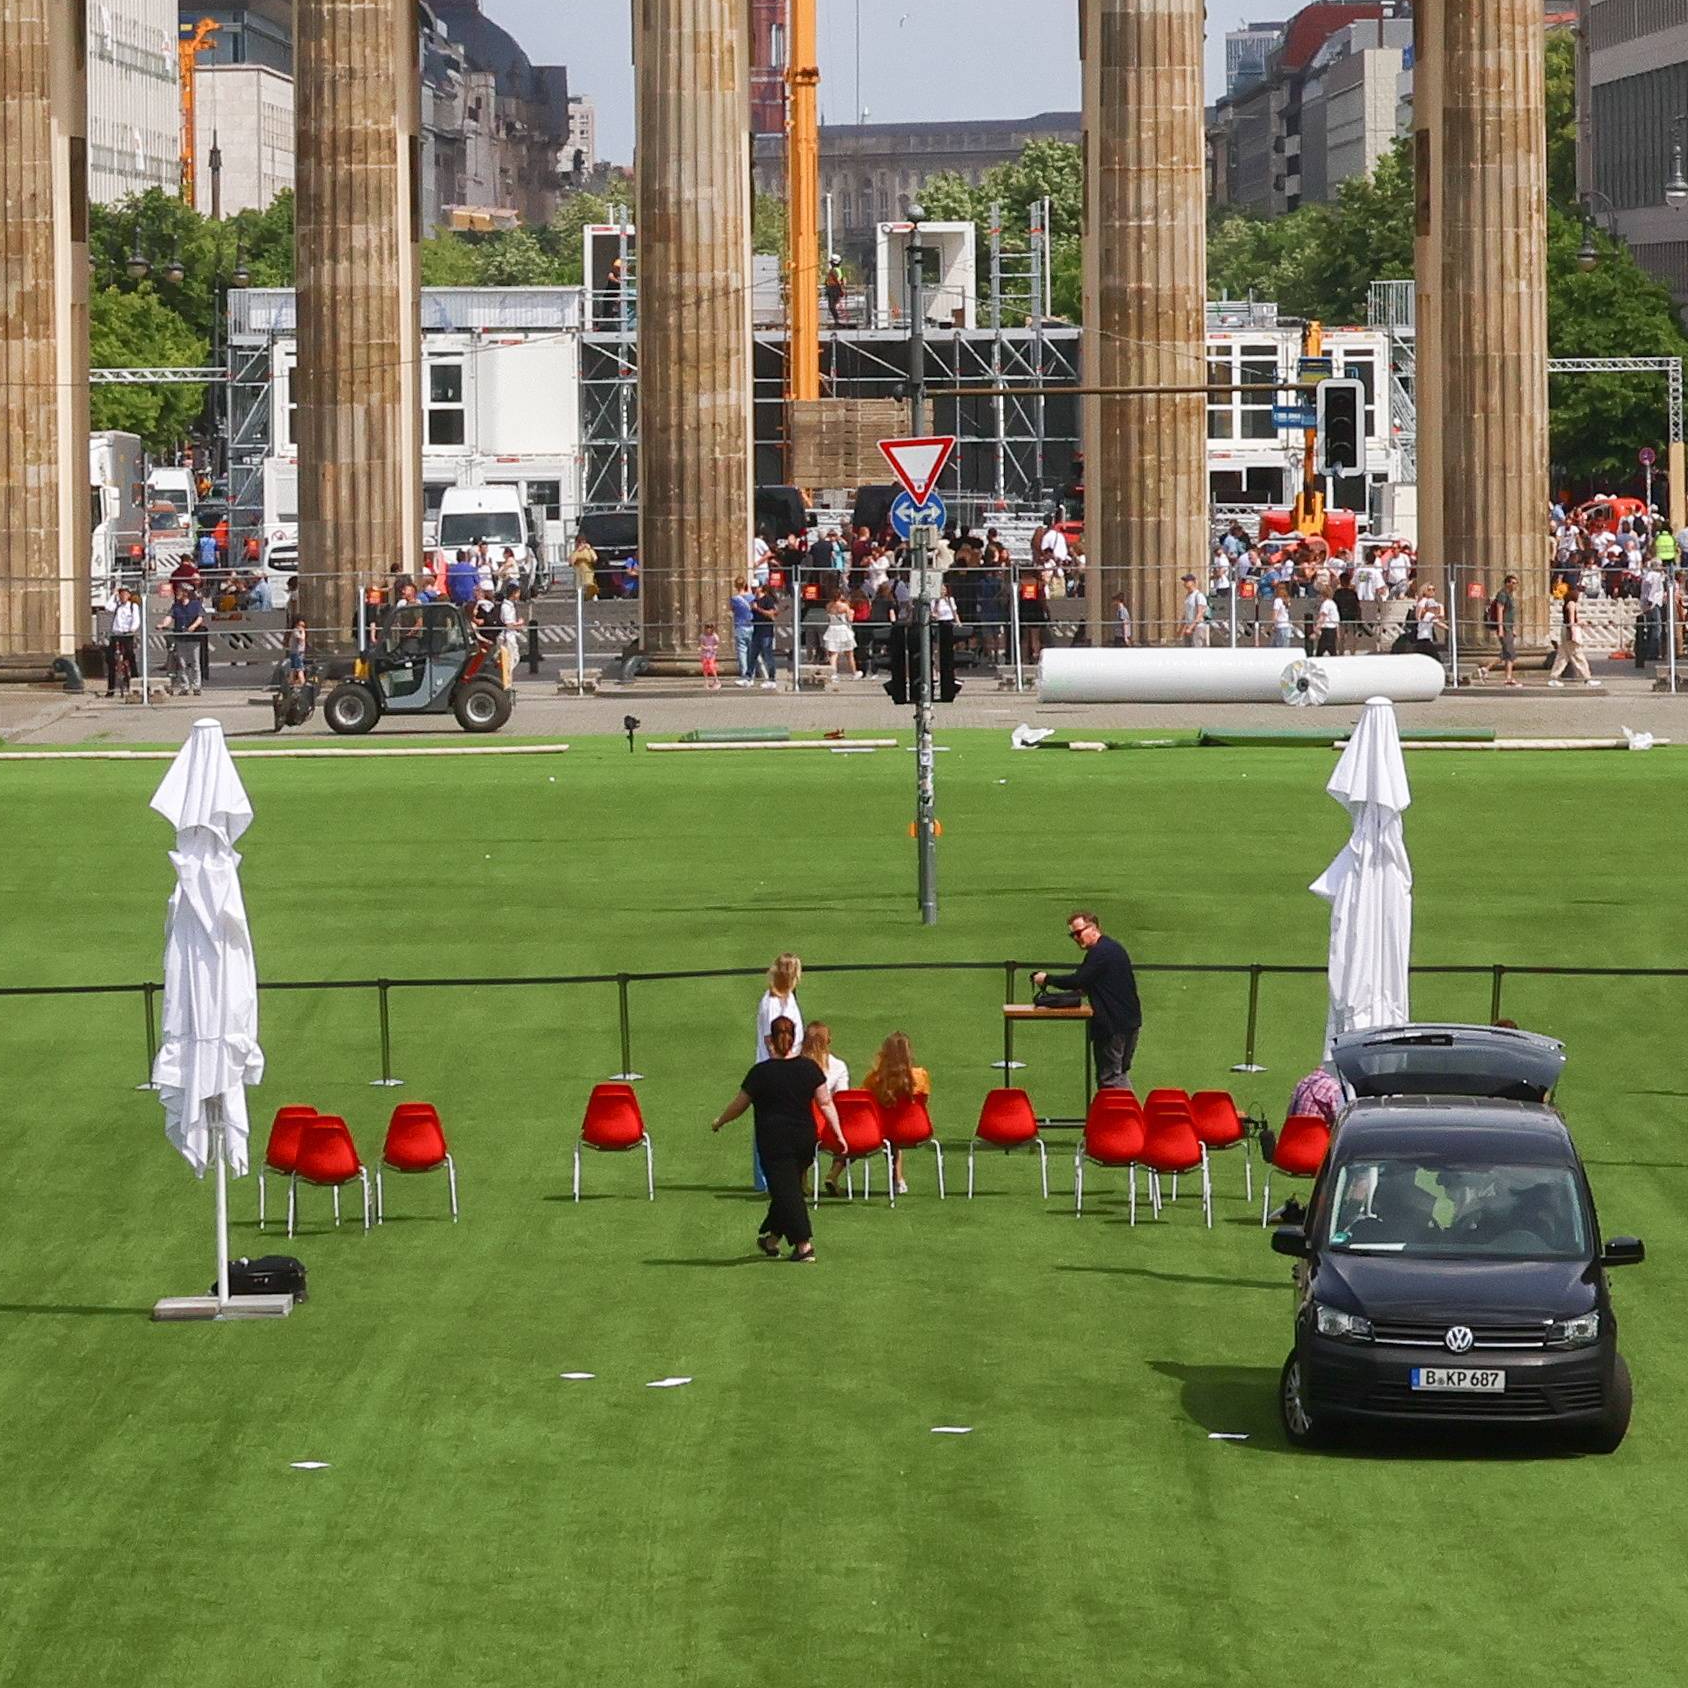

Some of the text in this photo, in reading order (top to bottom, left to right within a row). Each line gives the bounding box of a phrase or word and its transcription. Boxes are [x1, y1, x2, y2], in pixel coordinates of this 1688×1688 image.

[1425, 1370, 1500, 1387] B KP 687
